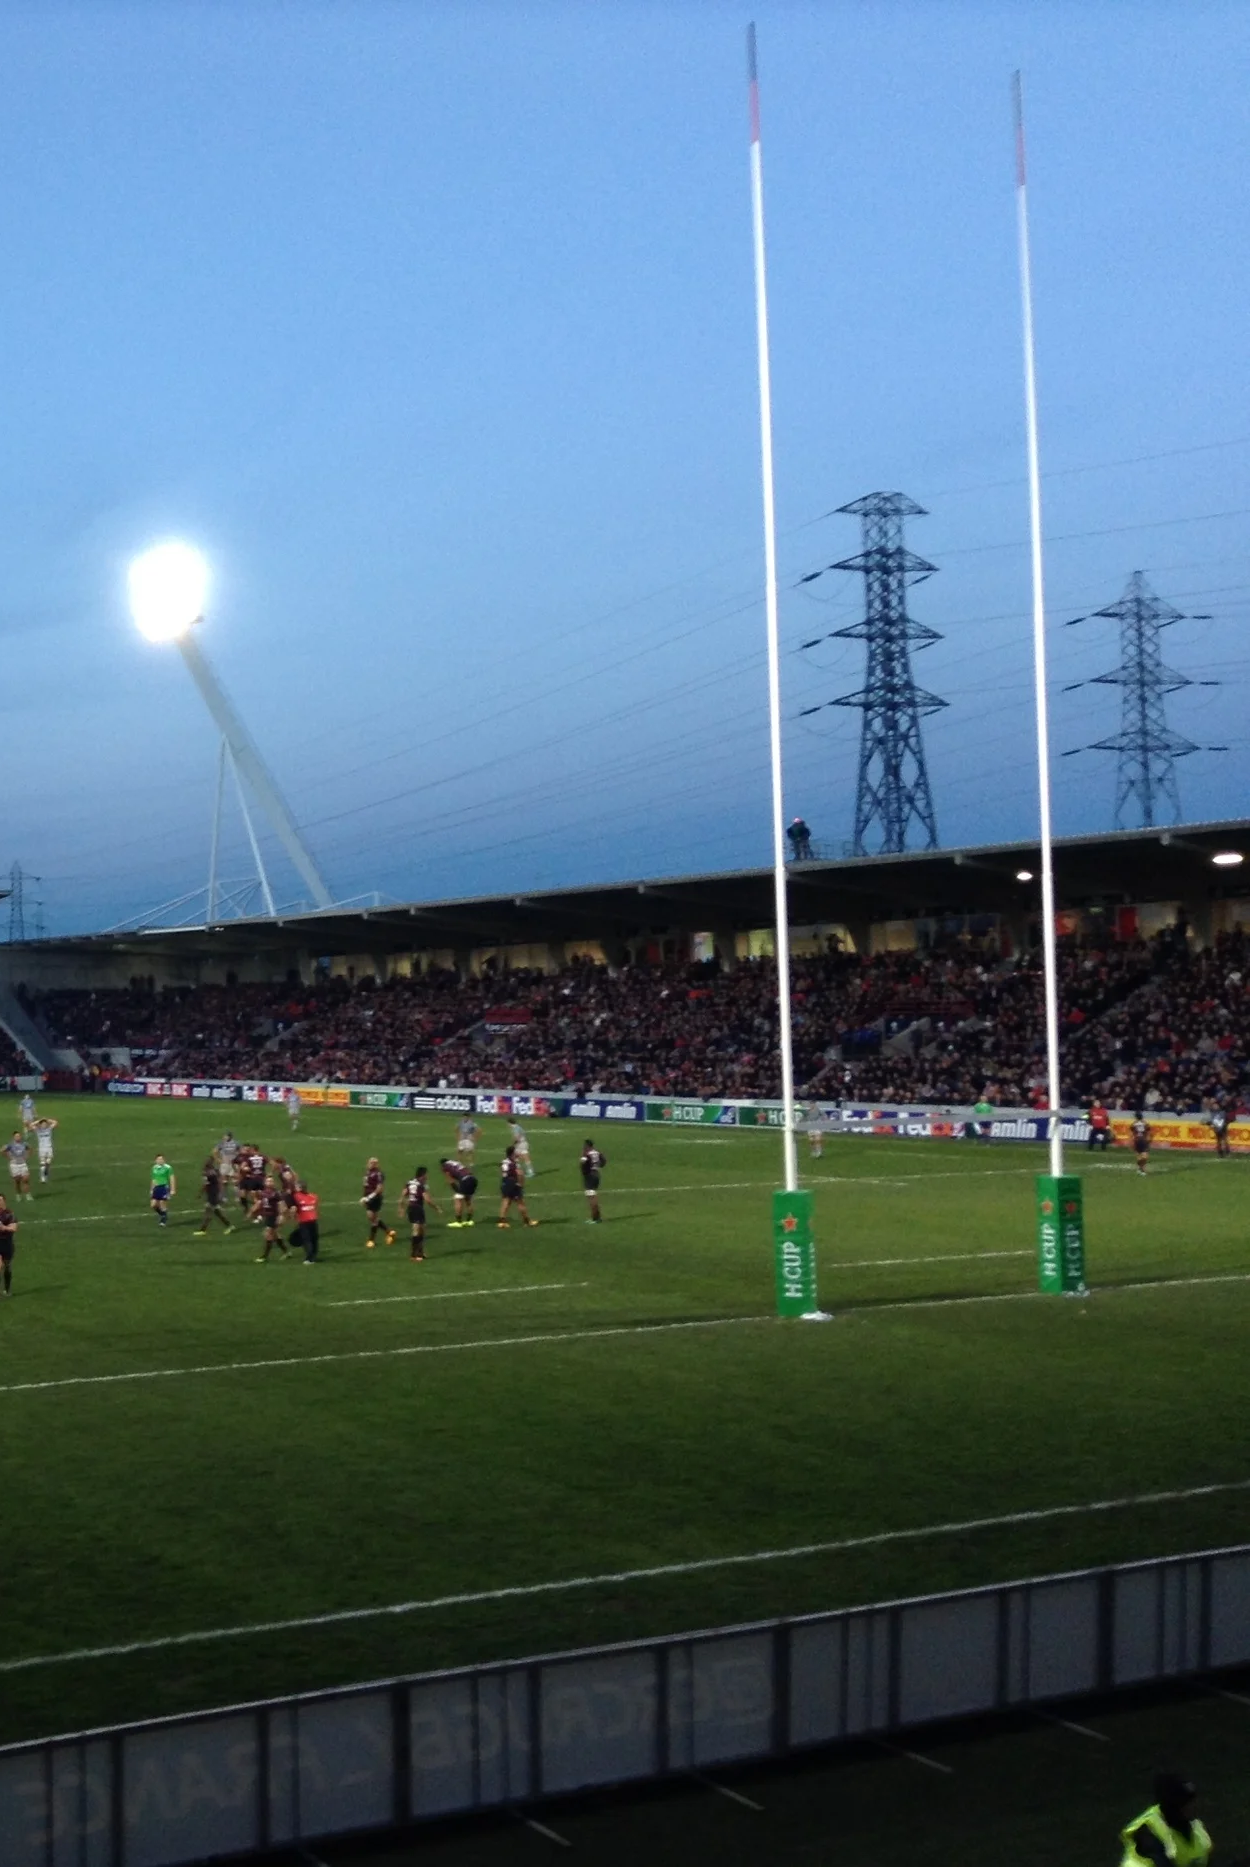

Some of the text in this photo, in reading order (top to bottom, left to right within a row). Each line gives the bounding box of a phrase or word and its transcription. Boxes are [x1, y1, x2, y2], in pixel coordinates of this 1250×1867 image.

[436, 1095, 471, 1111] adidas
[683, 1106, 705, 1120] CUP
[768, 1110, 778, 1124] H
[990, 1119, 1038, 1139] amlin
[1040, 1223, 1057, 1276] H CUP
[1064, 1224, 1081, 1277] H CUP
[782, 1241, 803, 1298] H CUP
